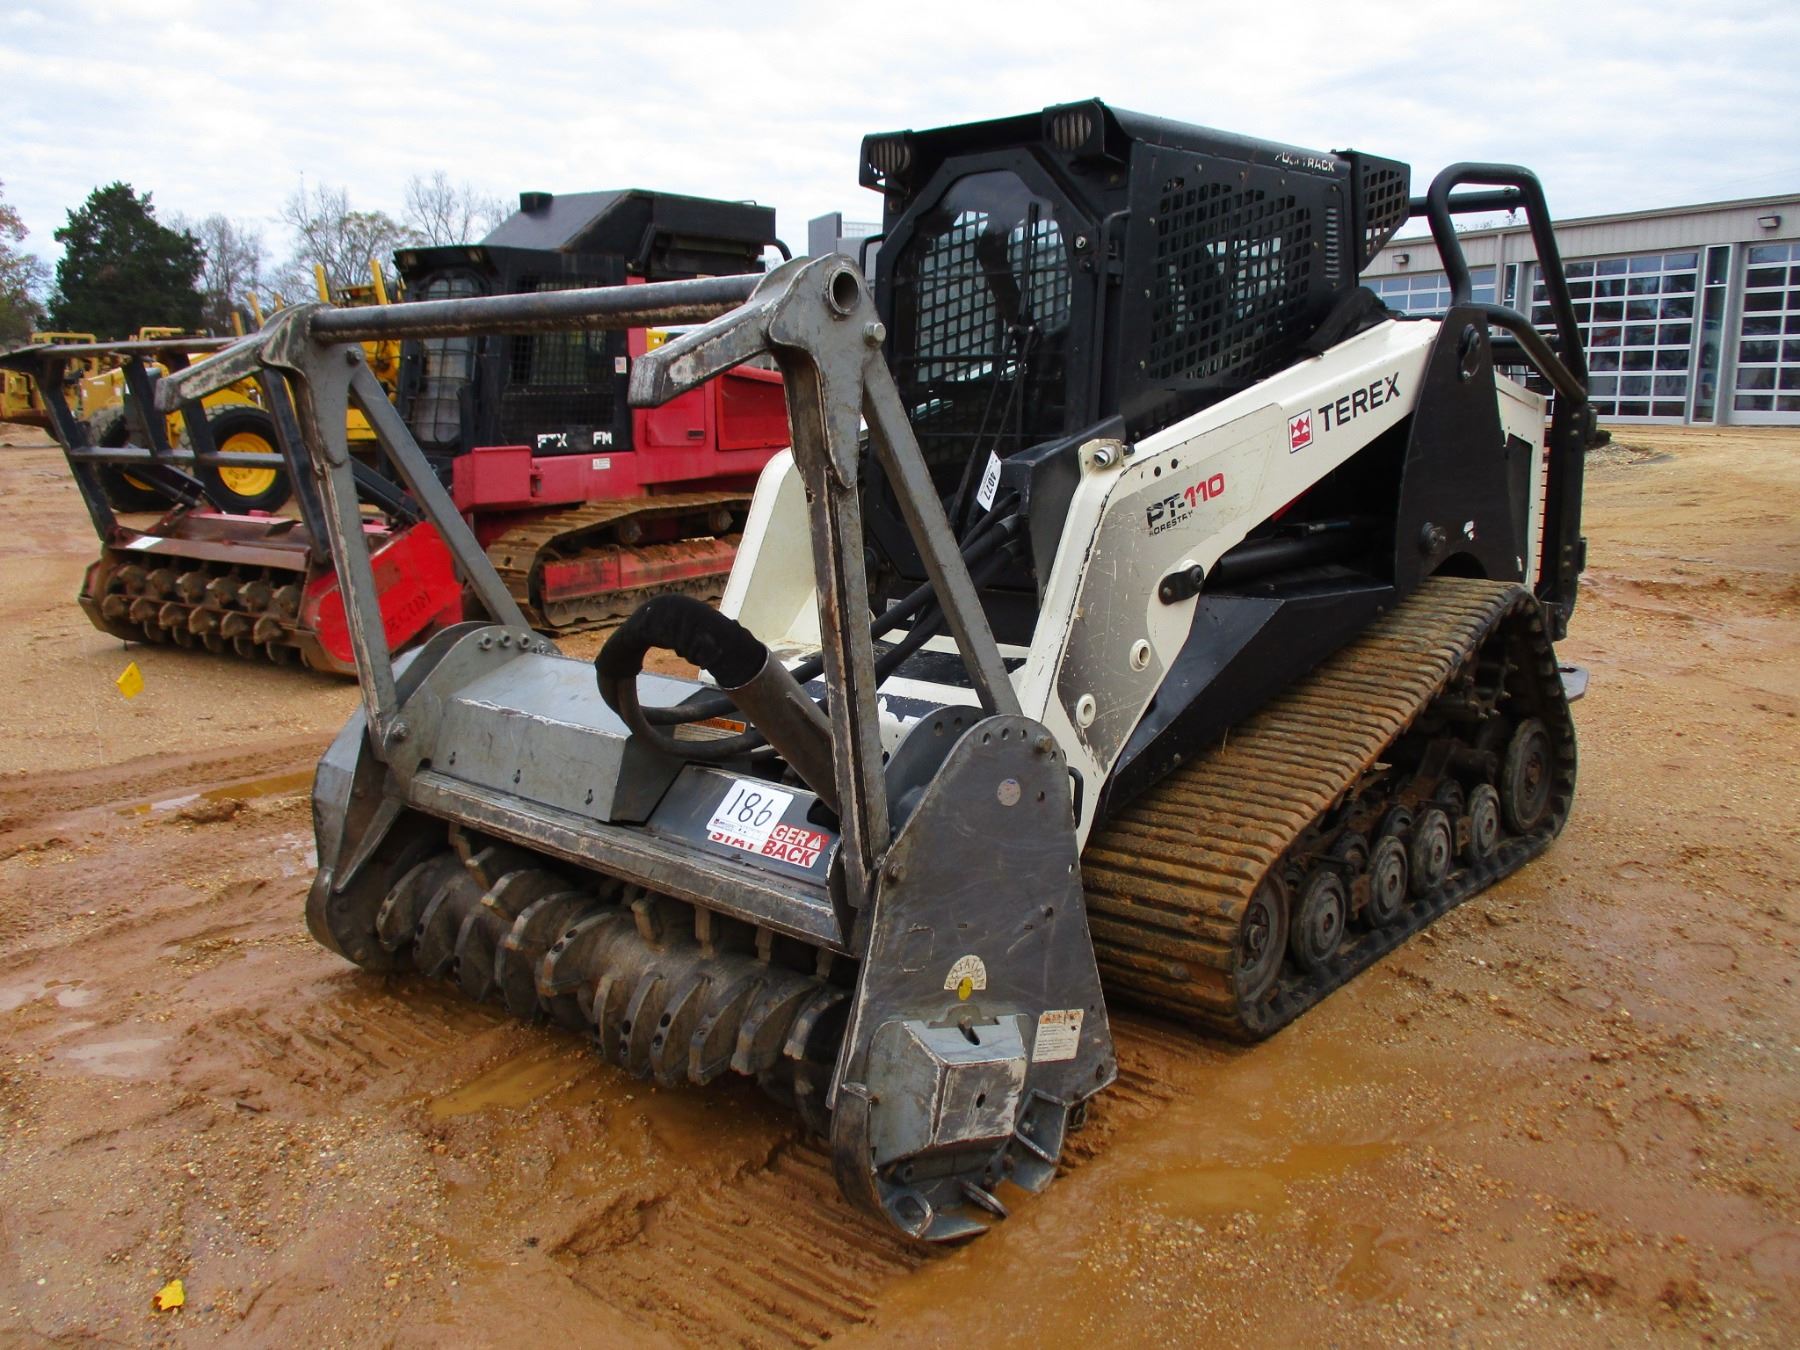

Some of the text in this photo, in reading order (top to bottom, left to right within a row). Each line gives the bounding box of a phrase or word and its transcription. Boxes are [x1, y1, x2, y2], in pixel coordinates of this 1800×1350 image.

[1318, 372, 1401, 432] TEREX
[593, 431, 612, 445] FM
[984, 471, 997, 501] 4077
[1146, 472, 1225, 528] PT-110
[727, 788, 774, 827] 186
[771, 825, 811, 847] GER
[761, 839, 817, 867] BACK
